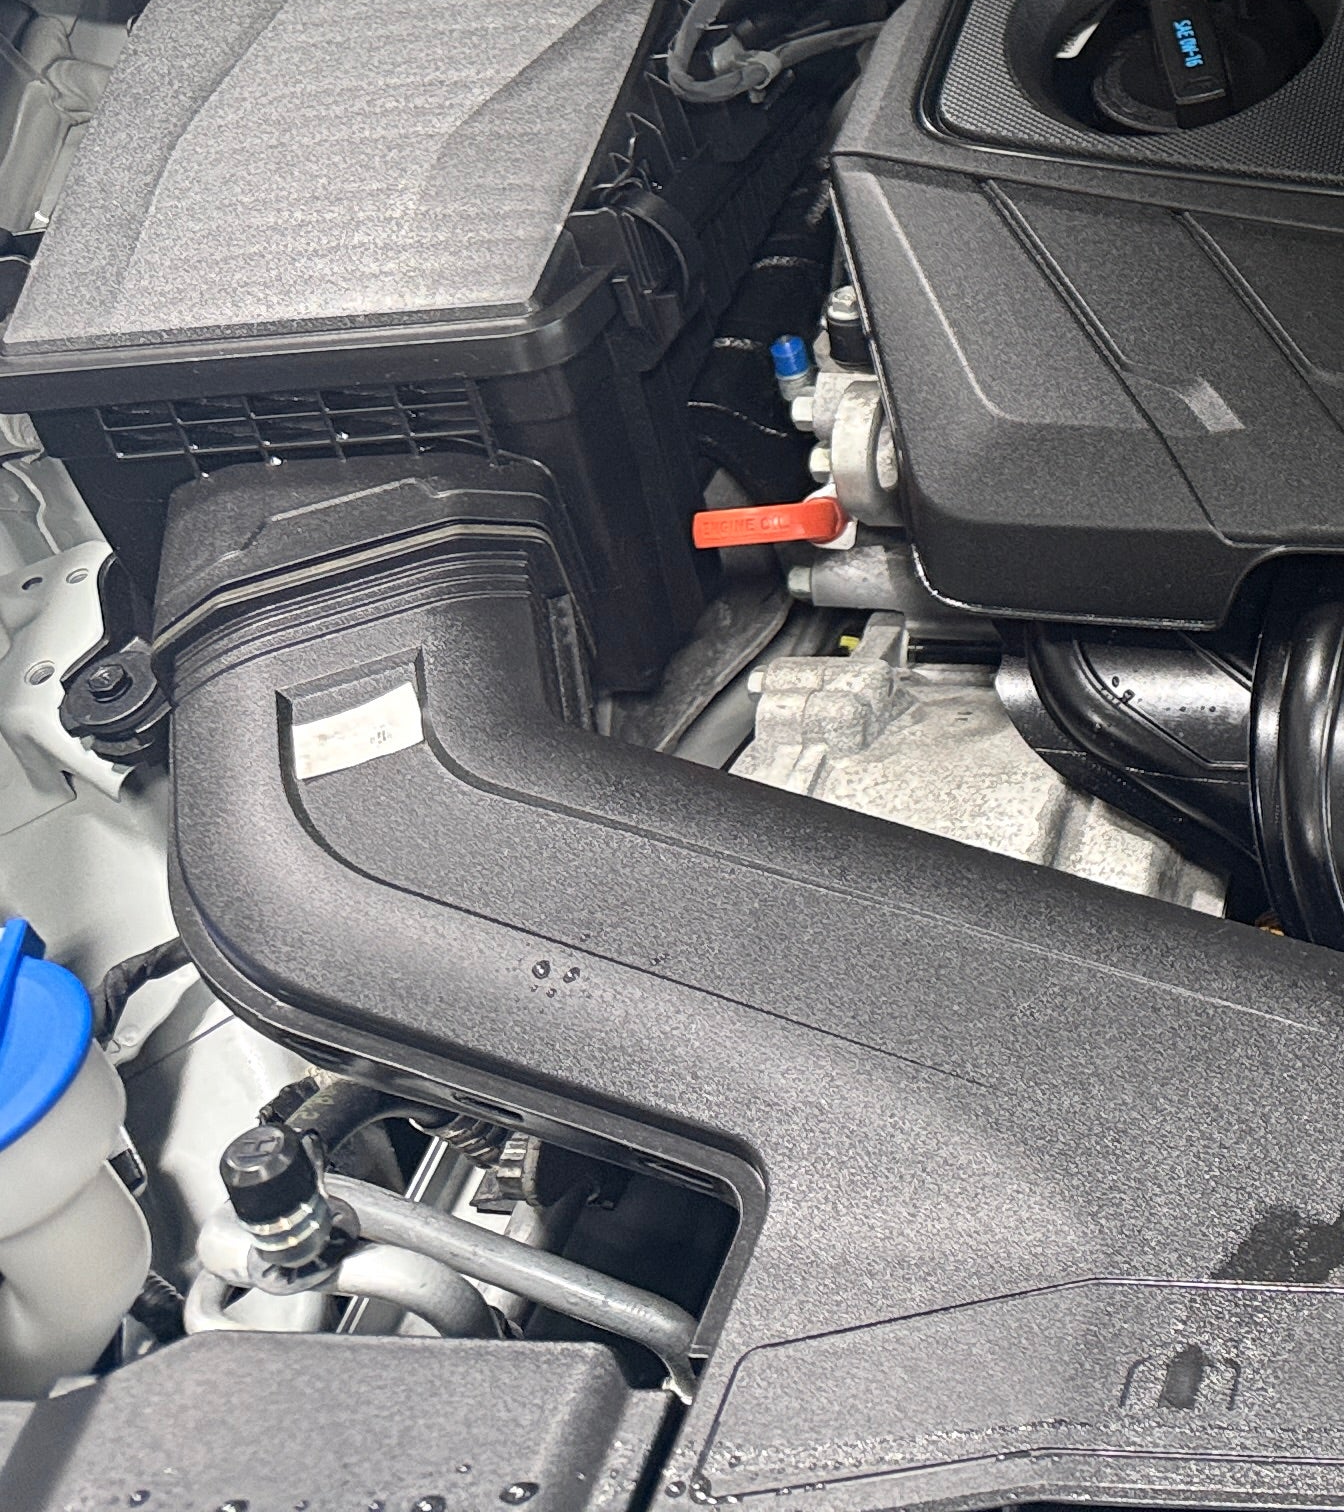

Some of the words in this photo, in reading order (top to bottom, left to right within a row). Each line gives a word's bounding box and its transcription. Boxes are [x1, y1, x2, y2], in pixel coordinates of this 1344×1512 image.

[1172, 19, 1195, 39] SAE
[703, 518, 755, 536] ENGINE
[760, 515, 790, 530] OIL
